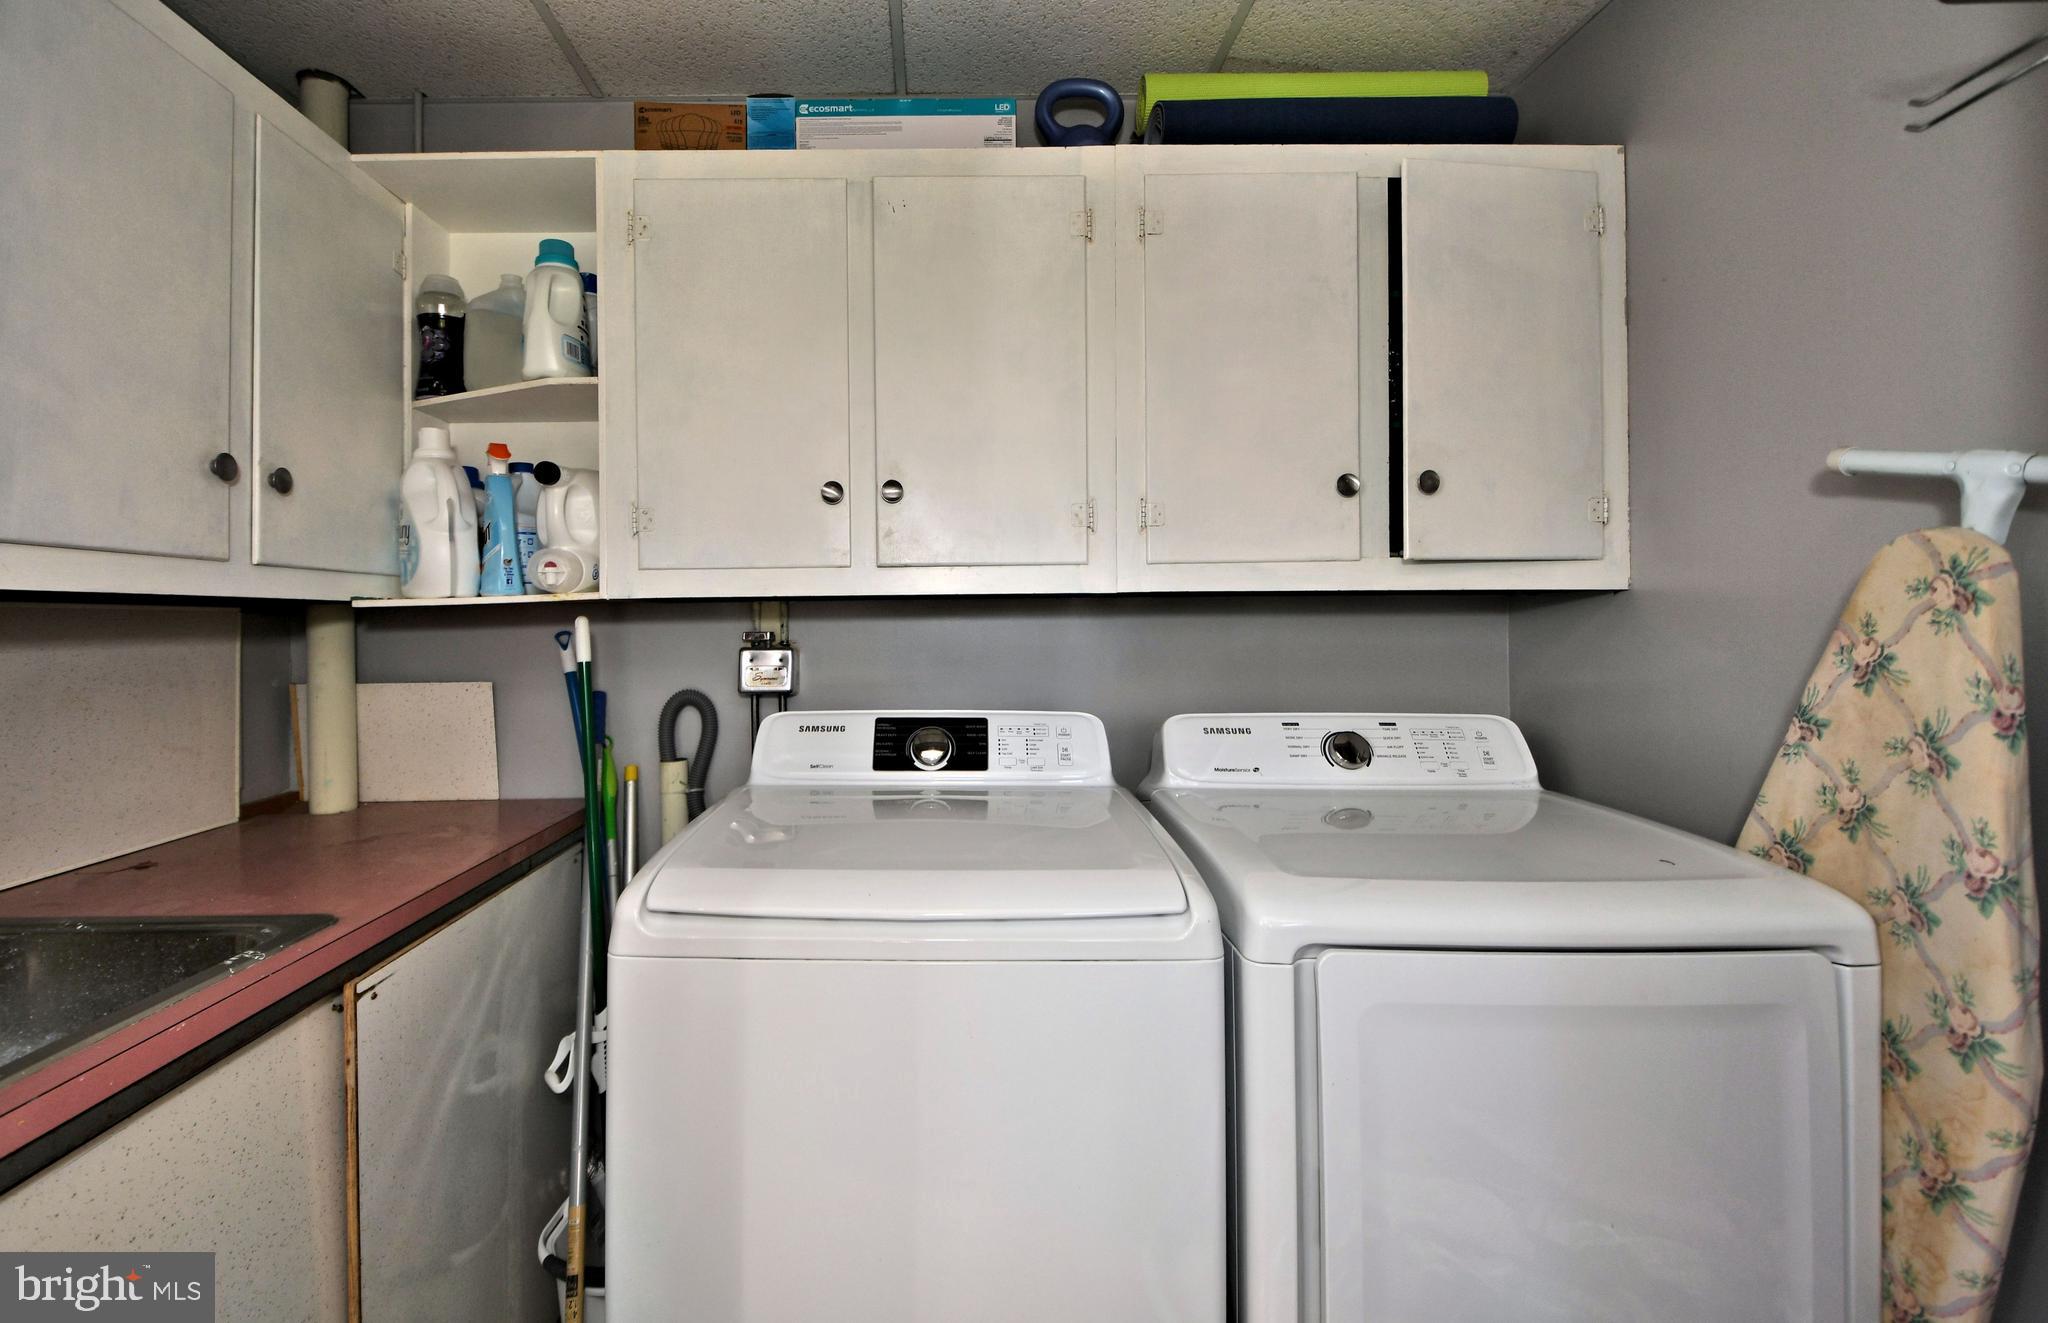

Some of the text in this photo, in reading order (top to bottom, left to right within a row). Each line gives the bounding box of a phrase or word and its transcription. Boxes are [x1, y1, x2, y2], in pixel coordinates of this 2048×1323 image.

[808, 104, 853, 112] ecosmart
[994, 103, 1010, 111] LED
[798, 725, 846, 733] SAMSUNG
[1202, 727, 1252, 735] SAMSUNG
